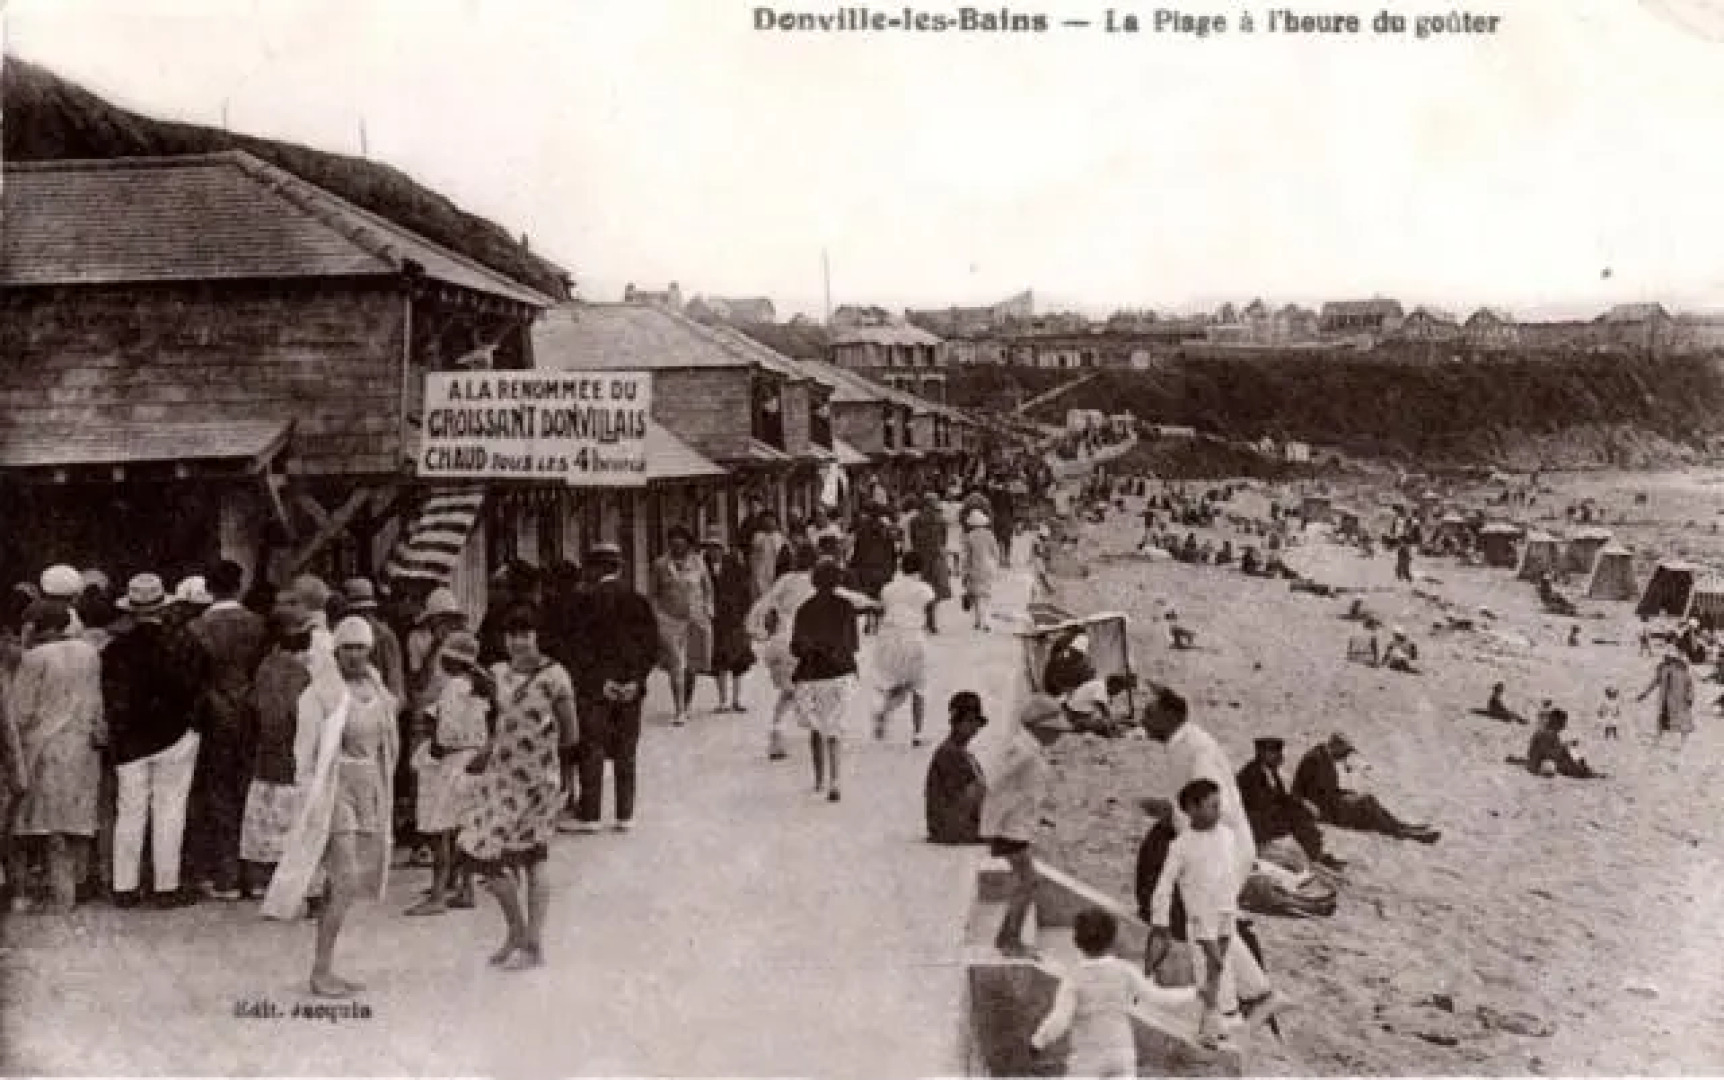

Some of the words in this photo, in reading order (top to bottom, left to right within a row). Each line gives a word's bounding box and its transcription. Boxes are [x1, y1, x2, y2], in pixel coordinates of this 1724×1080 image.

[448, 380, 461, 400] A
[466, 380, 491, 400] LA
[611, 381, 637, 400] DU
[428, 404, 535, 439] CROISSANT
[425, 447, 487, 469] CHAUD
[573, 447, 588, 471] 4
